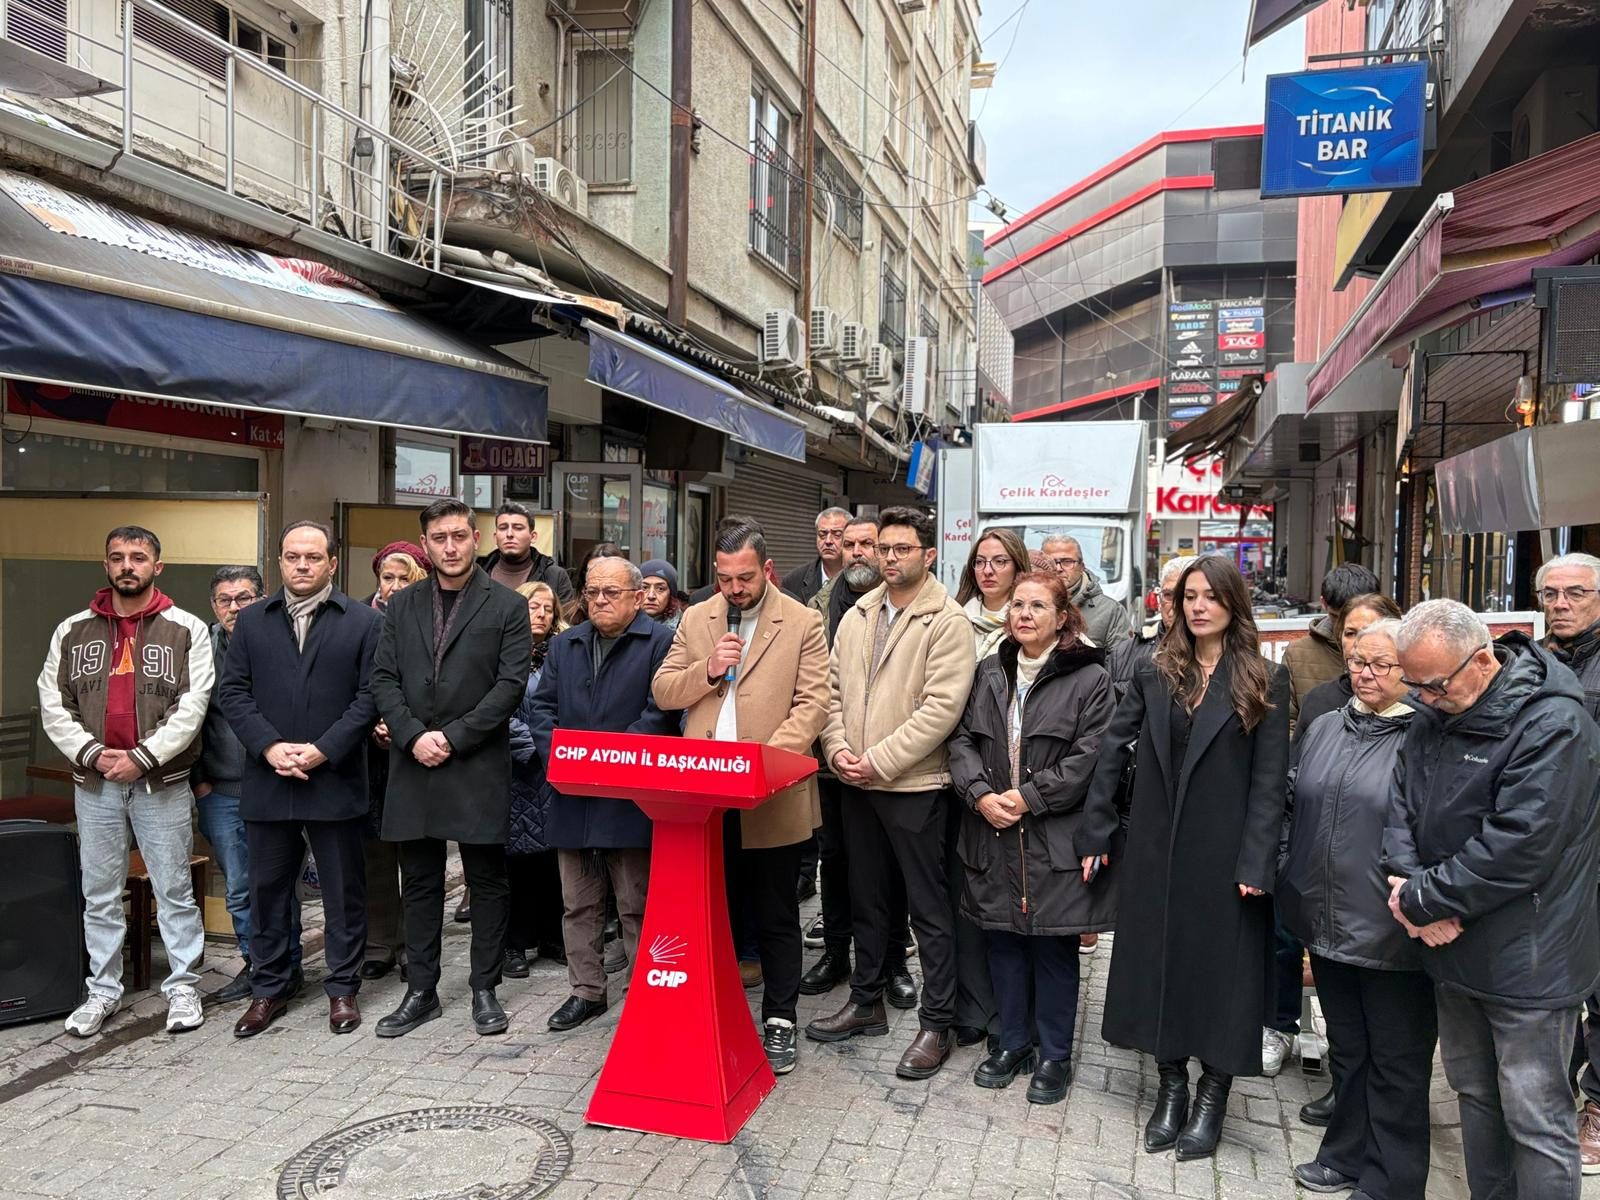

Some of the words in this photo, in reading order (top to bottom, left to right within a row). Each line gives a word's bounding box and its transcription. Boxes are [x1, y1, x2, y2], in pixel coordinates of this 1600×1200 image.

[1297, 104, 1392, 136] TİTANİK
[1317, 138, 1368, 161] BAR
[1171, 370, 1211, 380] KARACA
[250, 424, 269, 442] Kat
[489, 443, 542, 469] OCAĞI
[999, 487, 1036, 499] Çelik
[1039, 487, 1111, 499] Kardeşler
[71, 640, 106, 680] 19
[142, 644, 175, 684] 91
[554, 745, 588, 761] CHP
[590, 748, 637, 766] AYDIN
[640, 748, 653, 767] İL
[657, 753, 751, 774] BAŞKANLIĞI
[646, 968, 688, 988] CHP
